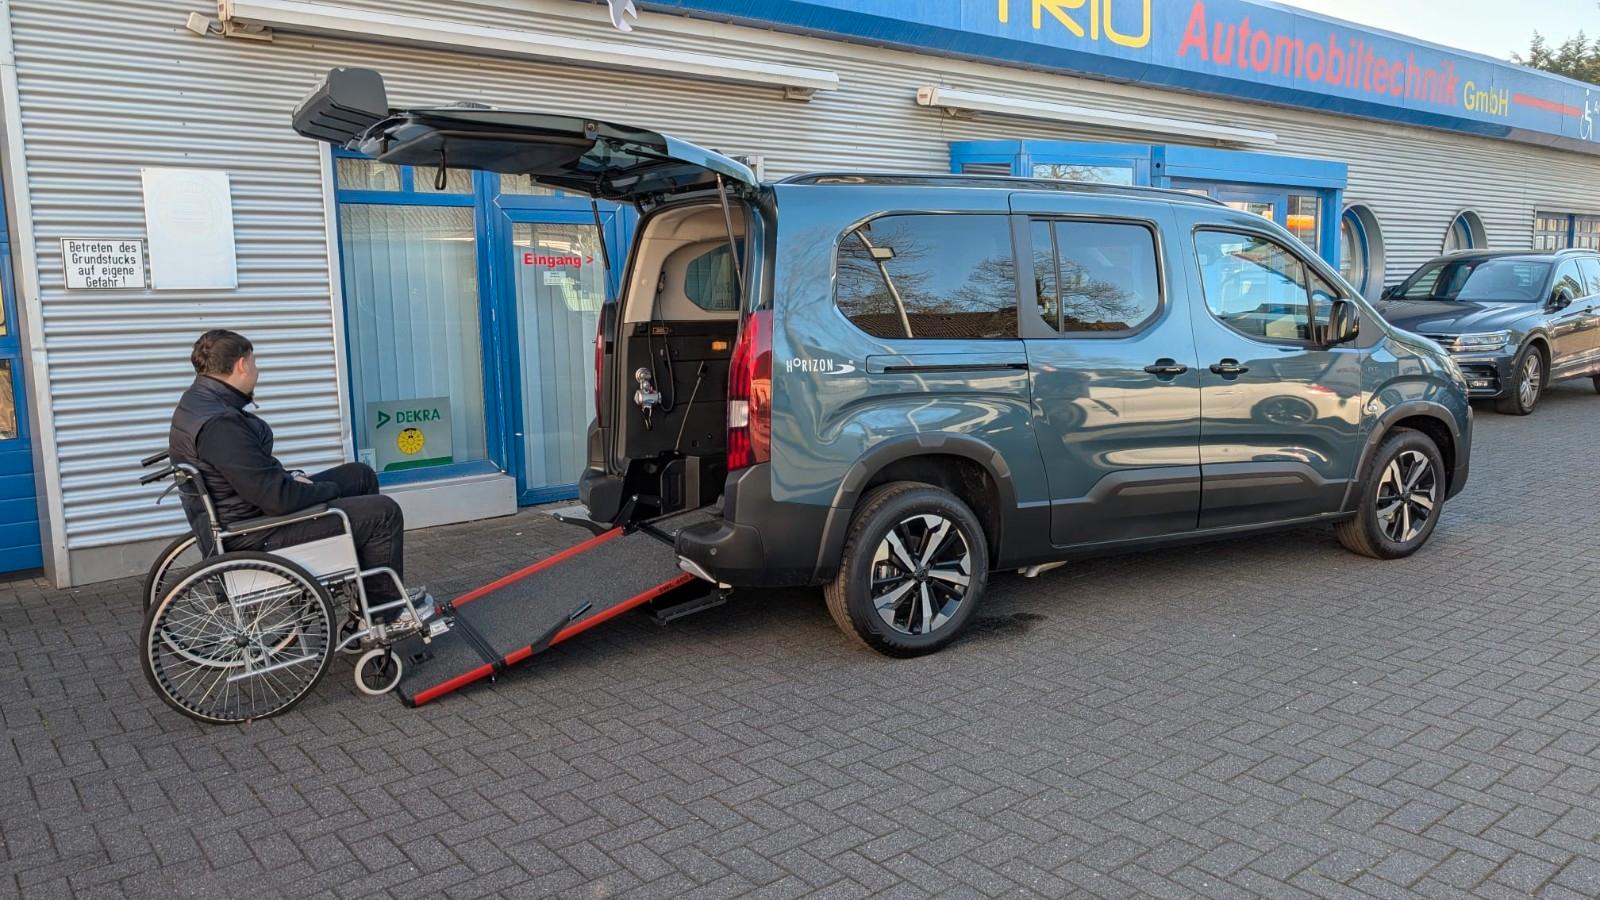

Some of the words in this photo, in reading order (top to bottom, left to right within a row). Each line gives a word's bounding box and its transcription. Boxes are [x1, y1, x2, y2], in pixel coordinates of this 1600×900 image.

[1178, 0, 1460, 107] Automobiltechnik
[1463, 80, 1509, 117] GmbH
[69, 241, 113, 253] Betreten
[119, 242, 137, 253] des
[524, 253, 582, 269] Eingang
[78, 265, 95, 276] auf
[102, 266, 135, 278] eigene
[86, 276, 119, 288] Gefahr
[786, 358, 834, 373] HORIZON
[396, 408, 441, 424] DEKRA
